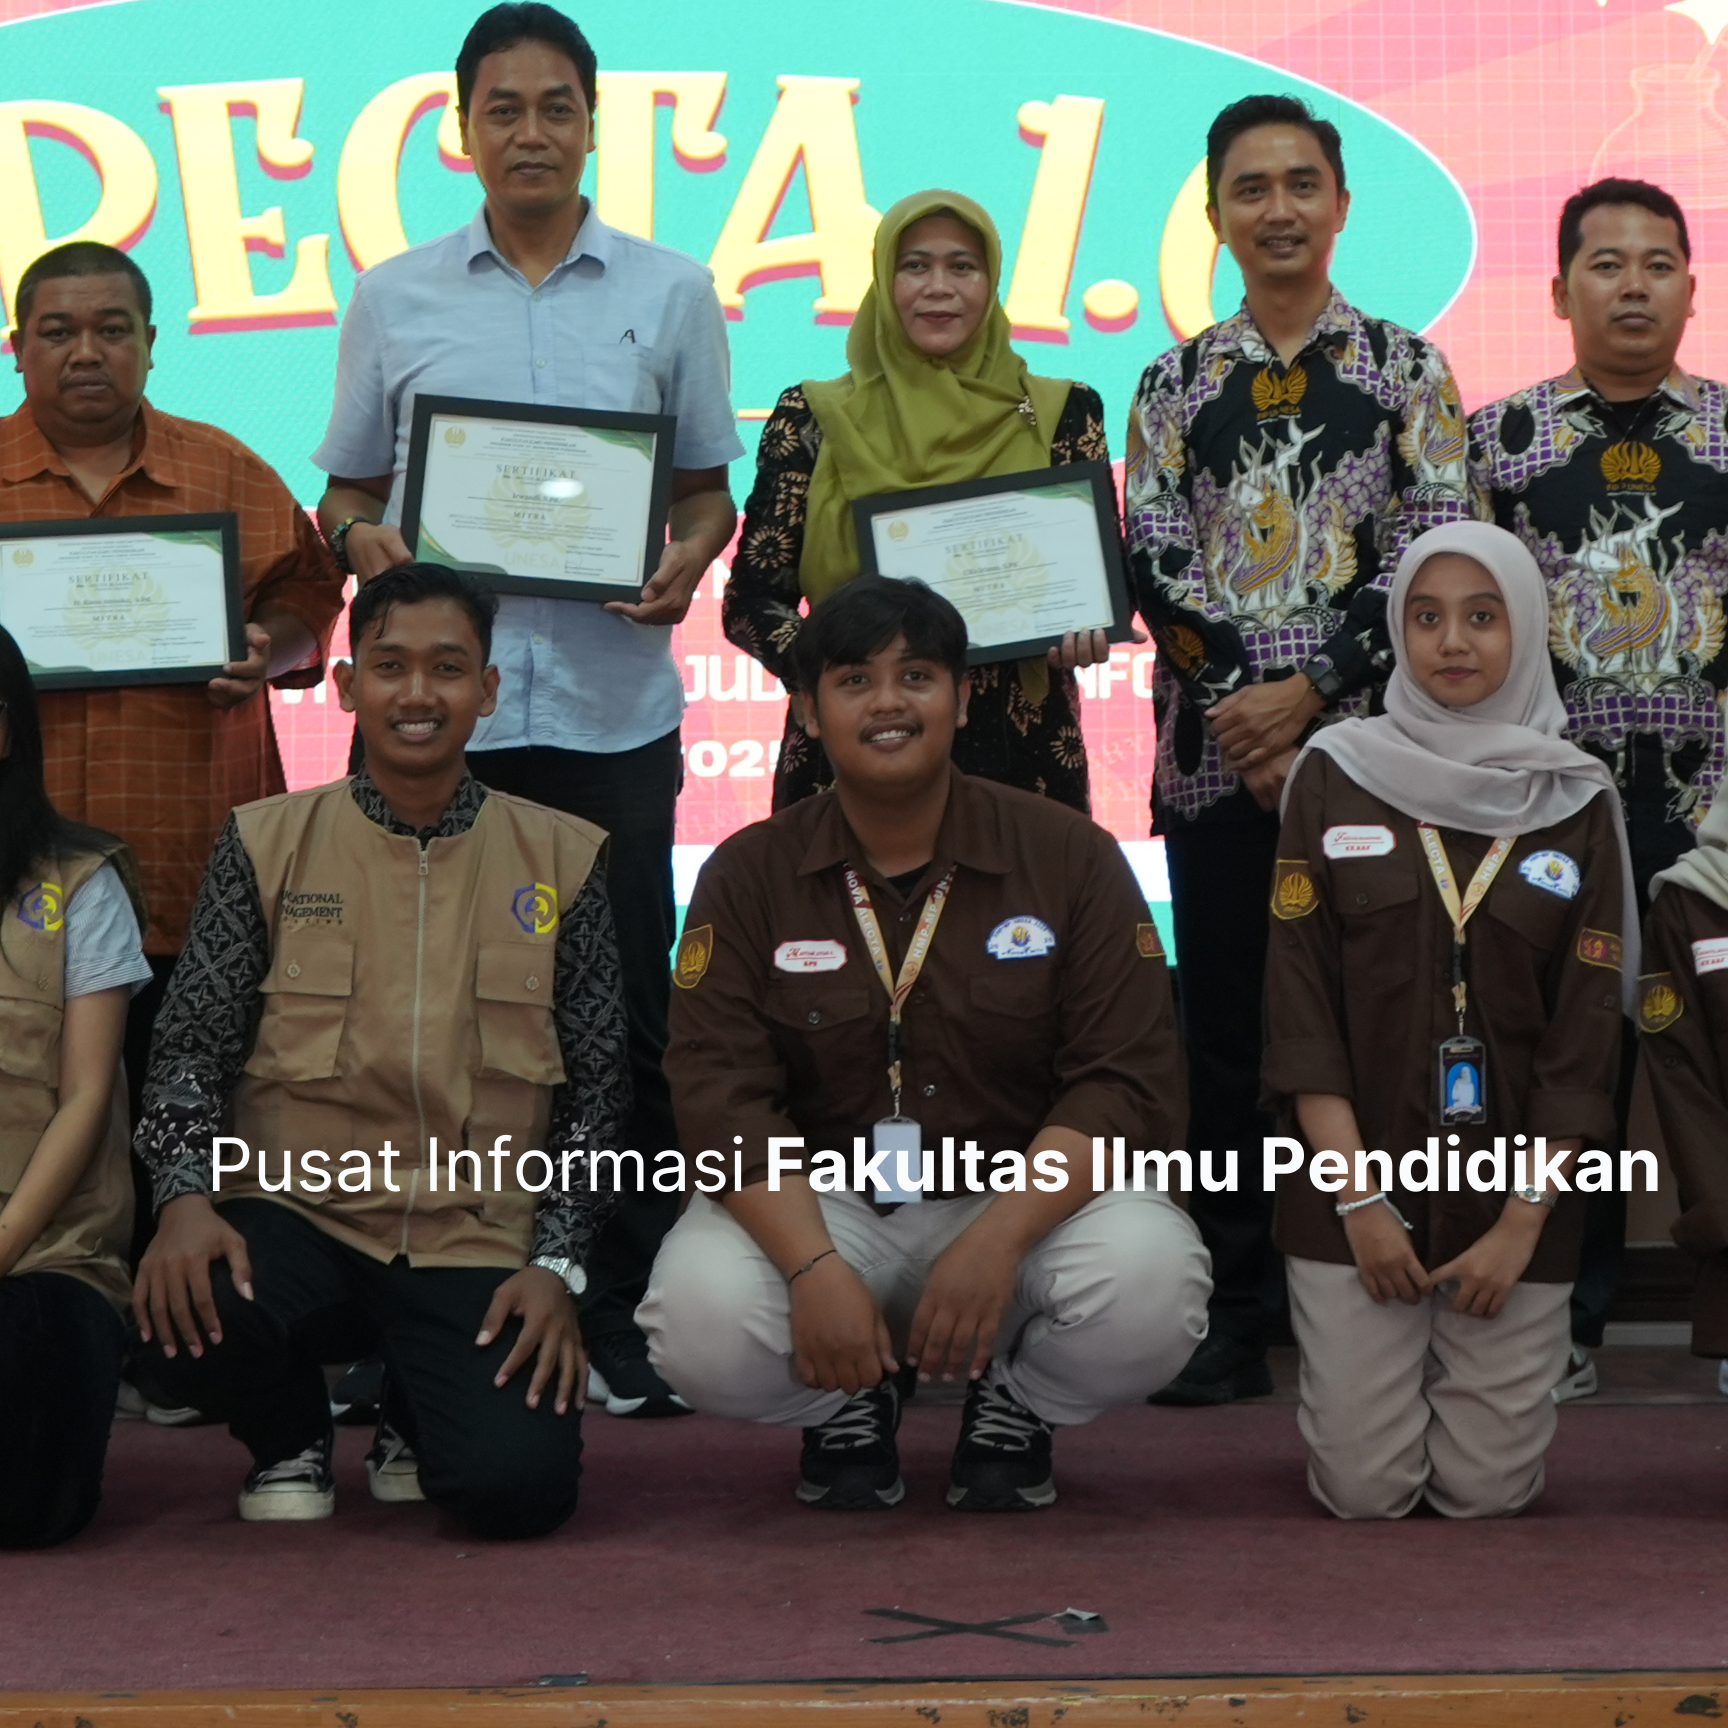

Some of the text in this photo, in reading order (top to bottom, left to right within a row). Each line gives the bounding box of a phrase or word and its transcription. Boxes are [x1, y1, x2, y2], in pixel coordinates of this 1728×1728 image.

[496, 464, 576, 479] SERTIFIKAT
[68, 571, 149, 584] SERTIFIKAT
[844, 870, 865, 905] NOVA
